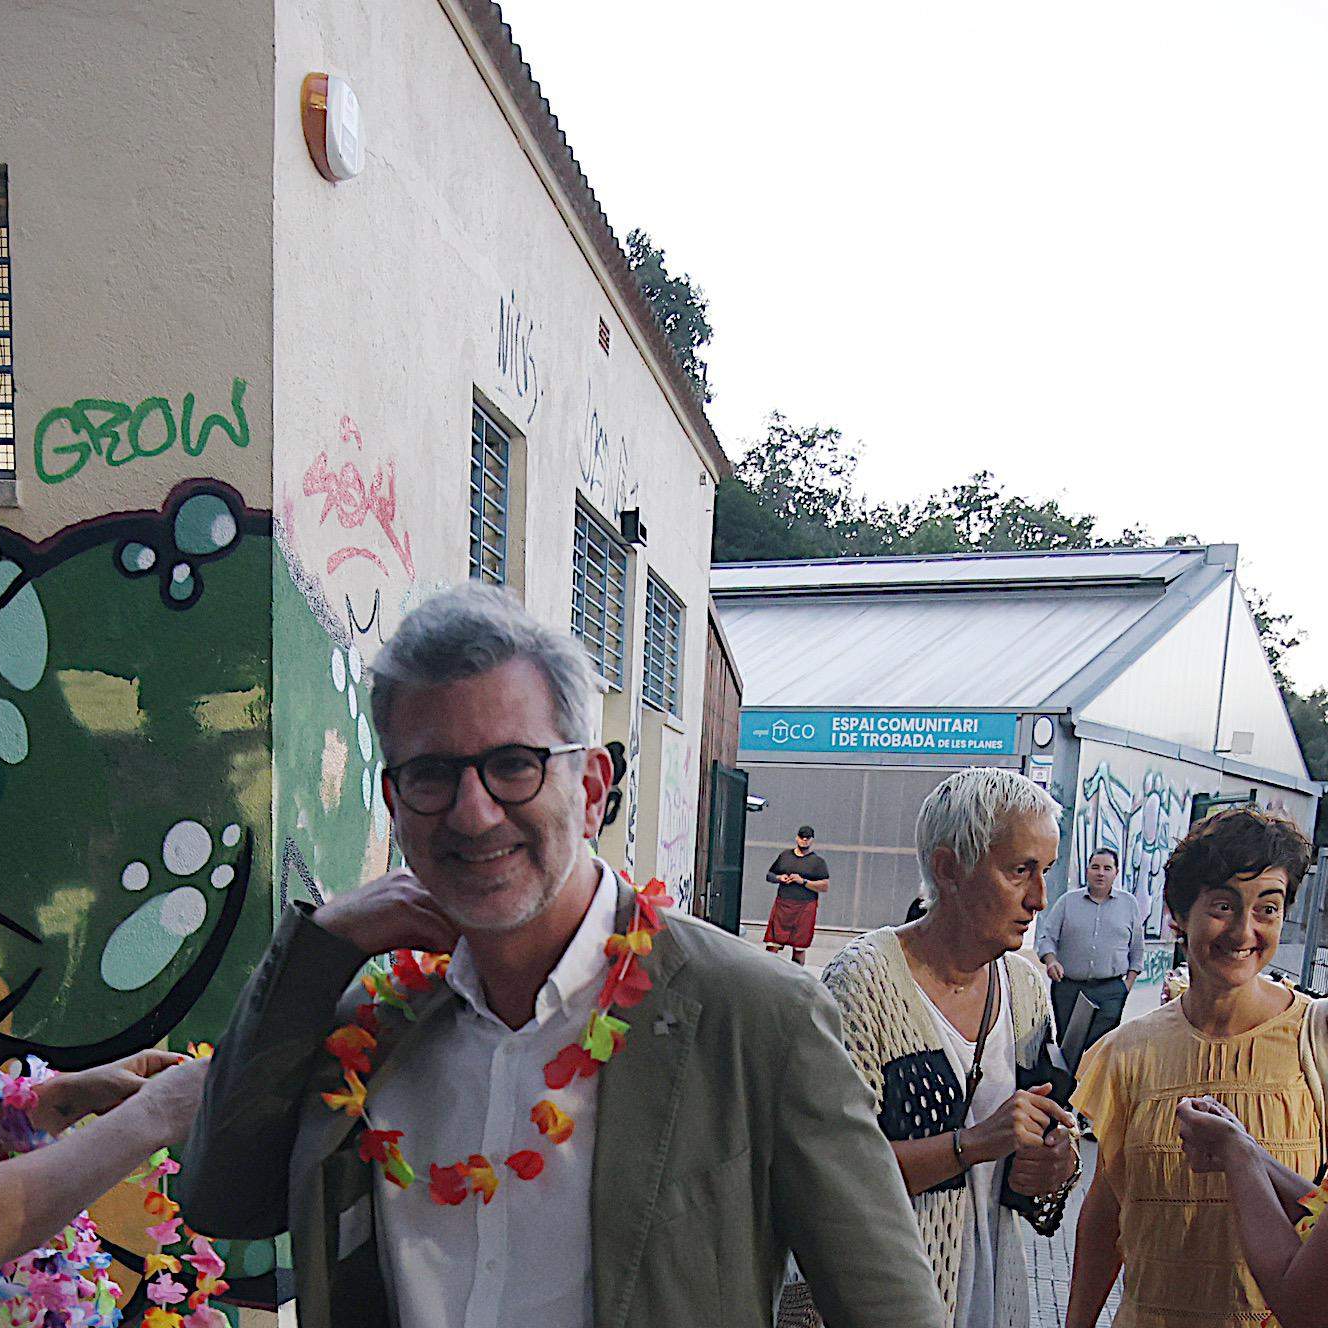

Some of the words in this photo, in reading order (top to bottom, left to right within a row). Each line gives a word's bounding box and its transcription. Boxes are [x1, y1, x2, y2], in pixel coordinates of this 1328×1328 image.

[34, 377, 250, 484] GROW
[832, 717, 874, 731] ESPAI
[877, 717, 978, 733] COMUNITARI
[839, 732, 858, 747] DE
[861, 733, 935, 748] TROBADA
[938, 739, 950, 748] DE
[951, 739, 966, 749] LES
[968, 740, 1003, 749] PLANES
